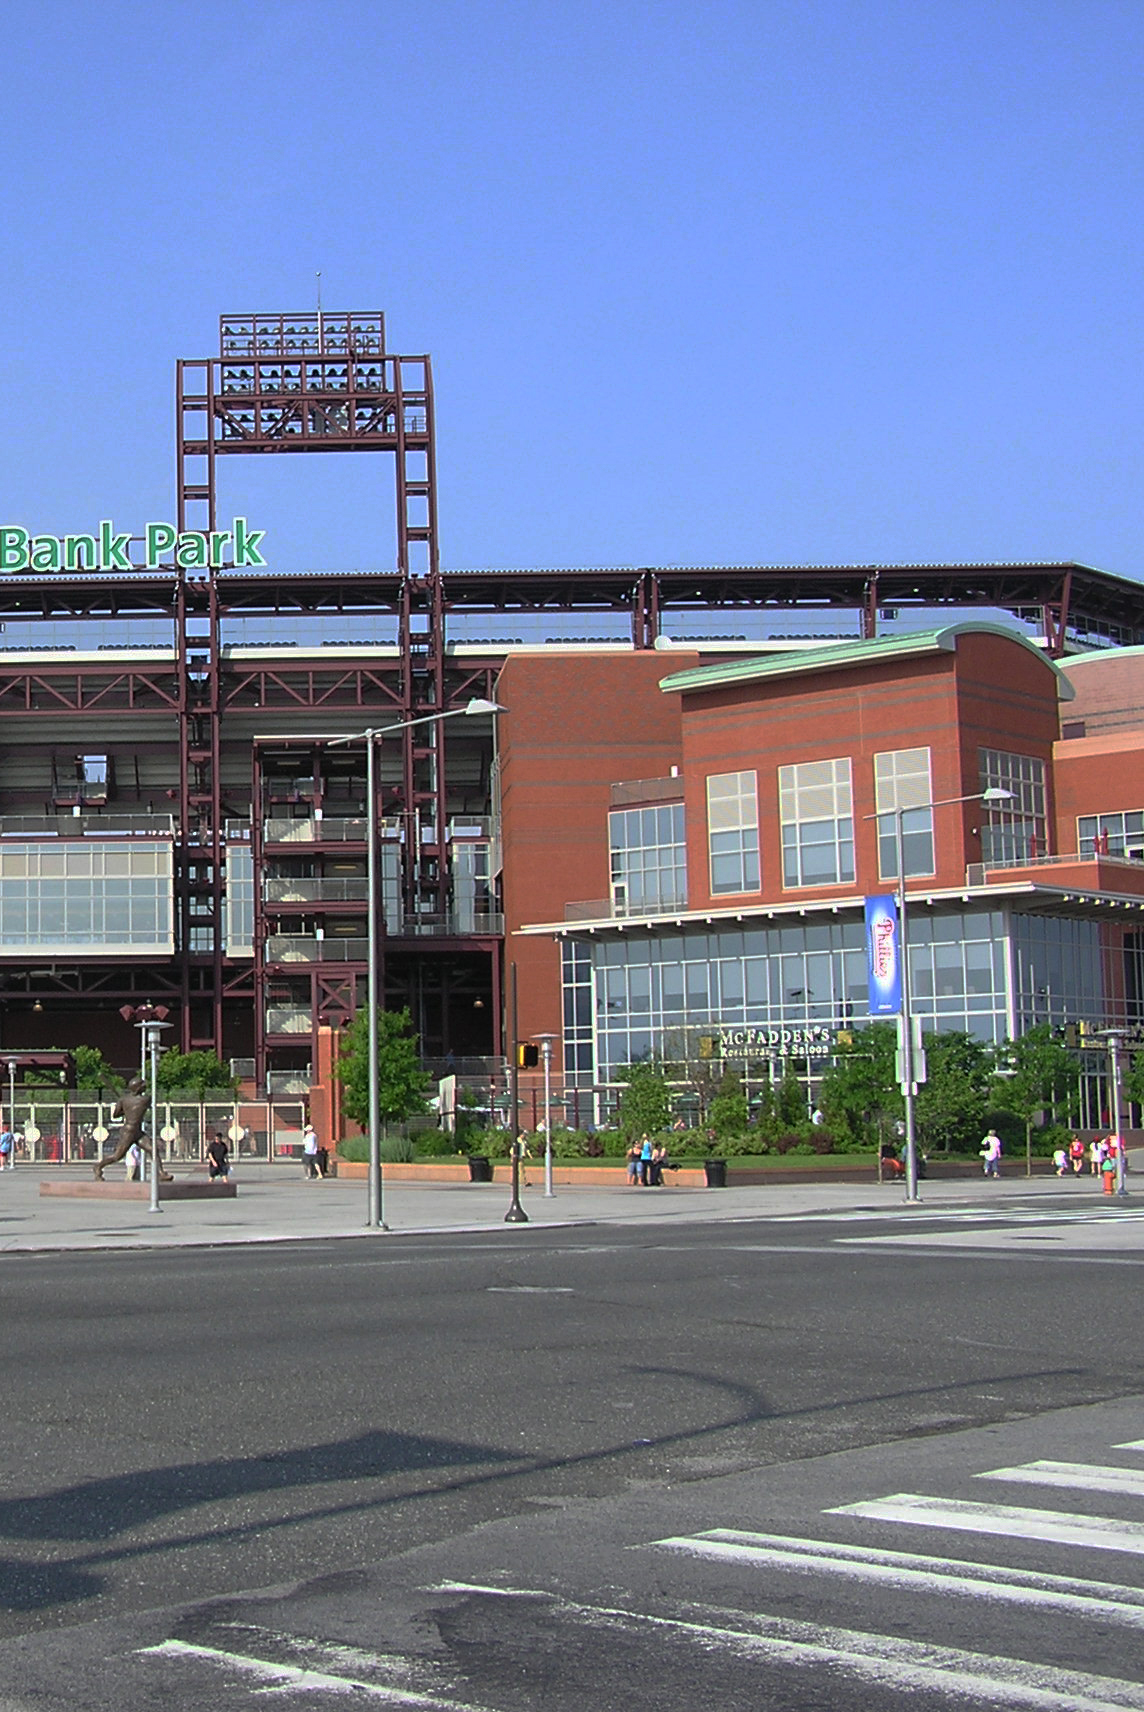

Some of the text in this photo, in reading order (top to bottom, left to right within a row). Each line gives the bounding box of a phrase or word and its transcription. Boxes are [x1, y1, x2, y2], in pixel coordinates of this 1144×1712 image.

[145, 517, 268, 570] Park
[873, 917, 895, 978] Phillies
[778, 1044, 788, 1056] &
[792, 1044, 829, 1056] Saloon
